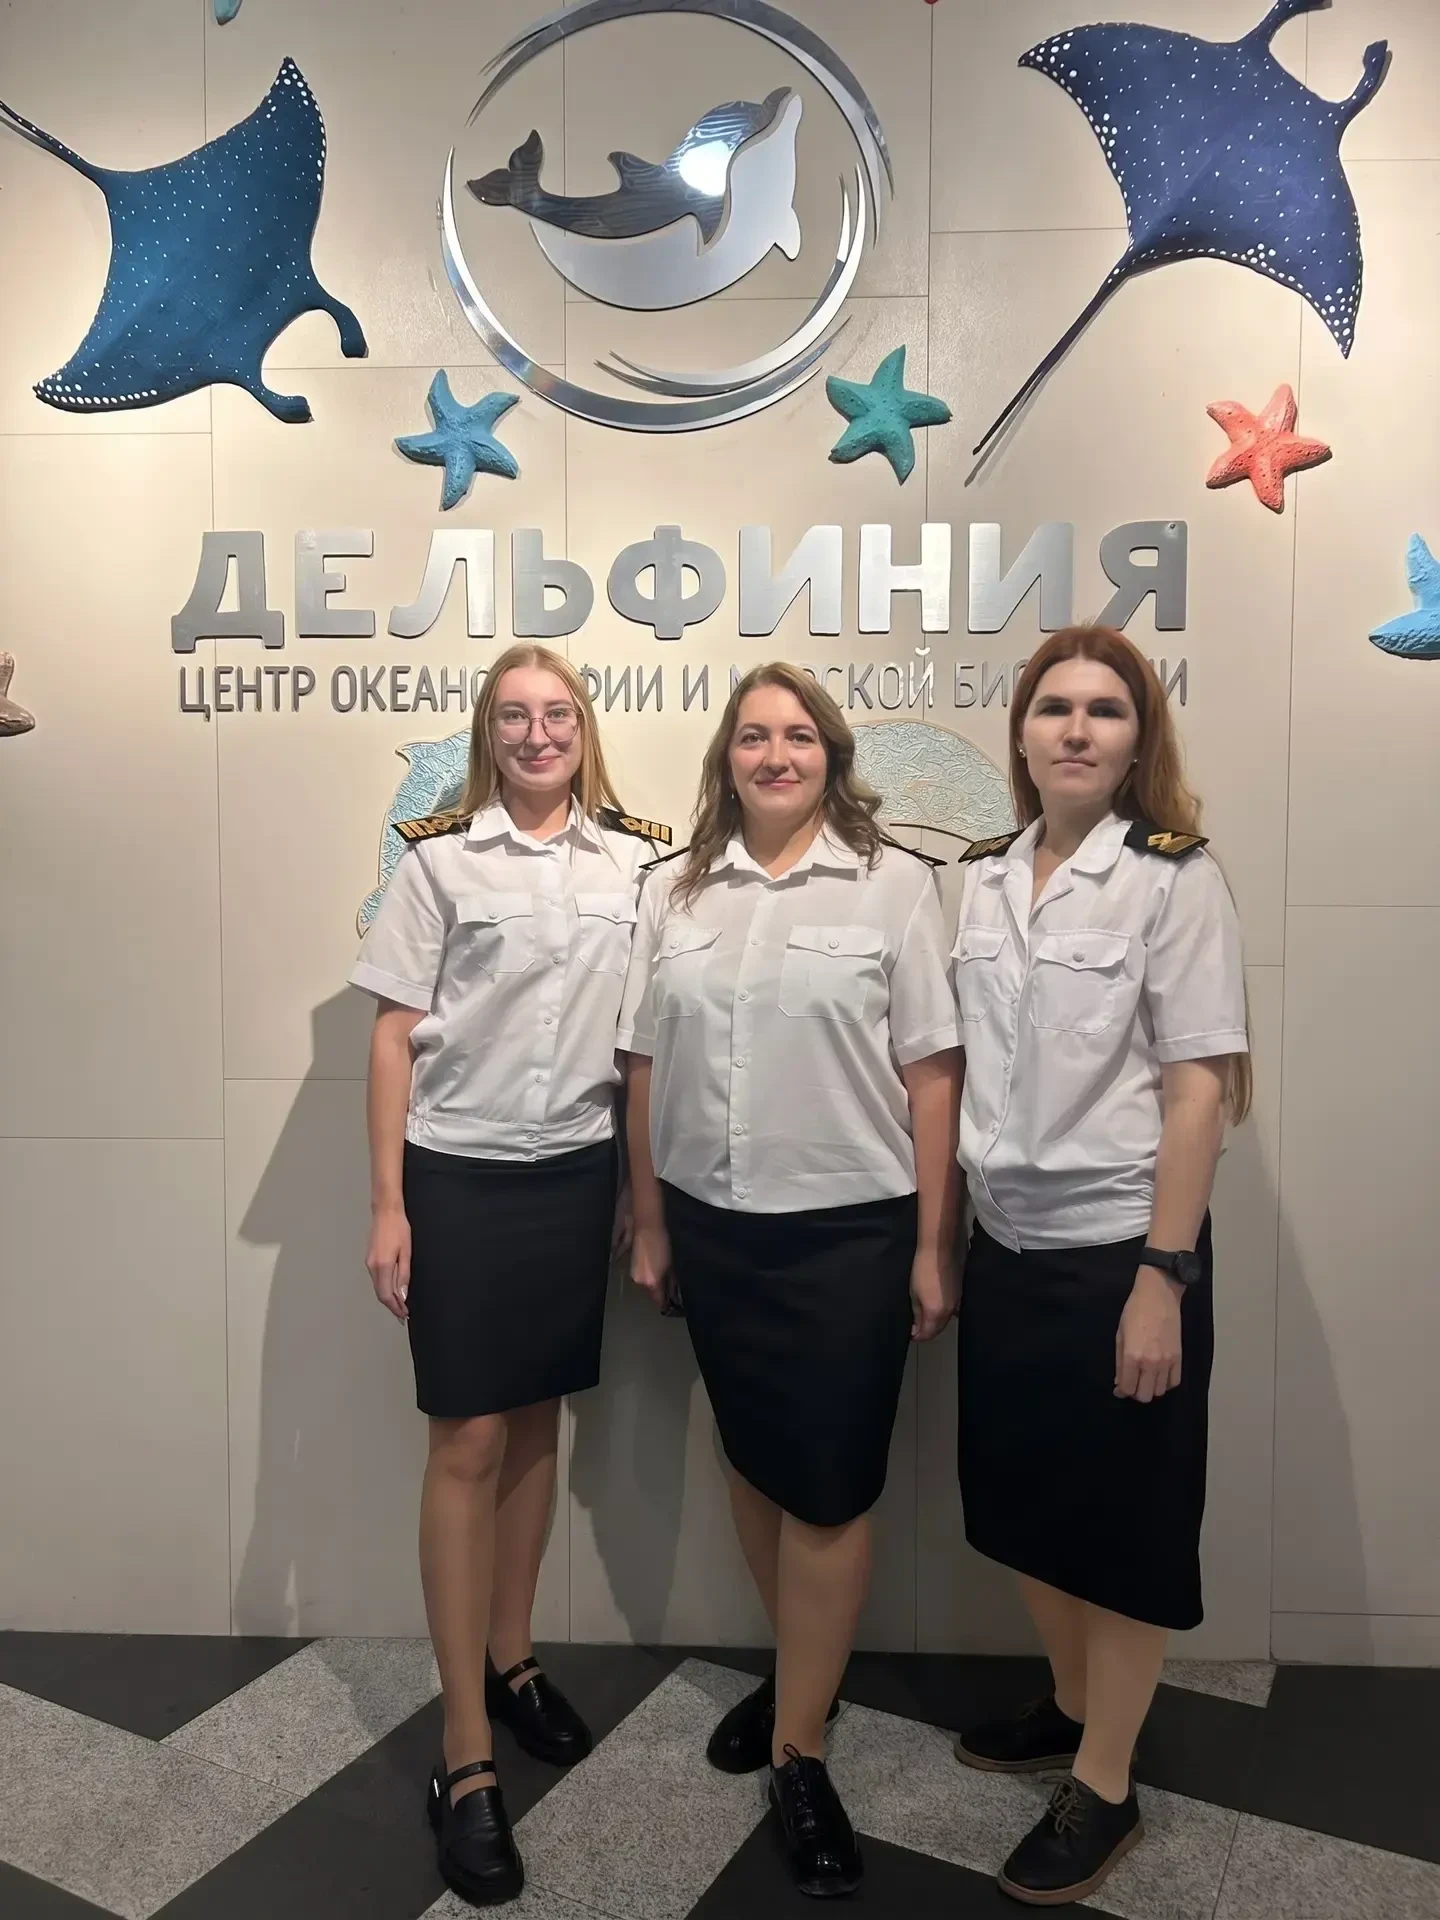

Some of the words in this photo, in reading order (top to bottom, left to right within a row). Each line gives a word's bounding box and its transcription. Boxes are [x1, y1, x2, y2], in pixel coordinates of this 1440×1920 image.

[171, 520, 1188, 653] ДЕЛЬФИНИЯ
[179, 664, 316, 722] ЦЕНТР
[331, 662, 664, 713] ОКЕАНОФИИ
[683, 663, 709, 712] И
[730, 647, 935, 711] СКОЙ
